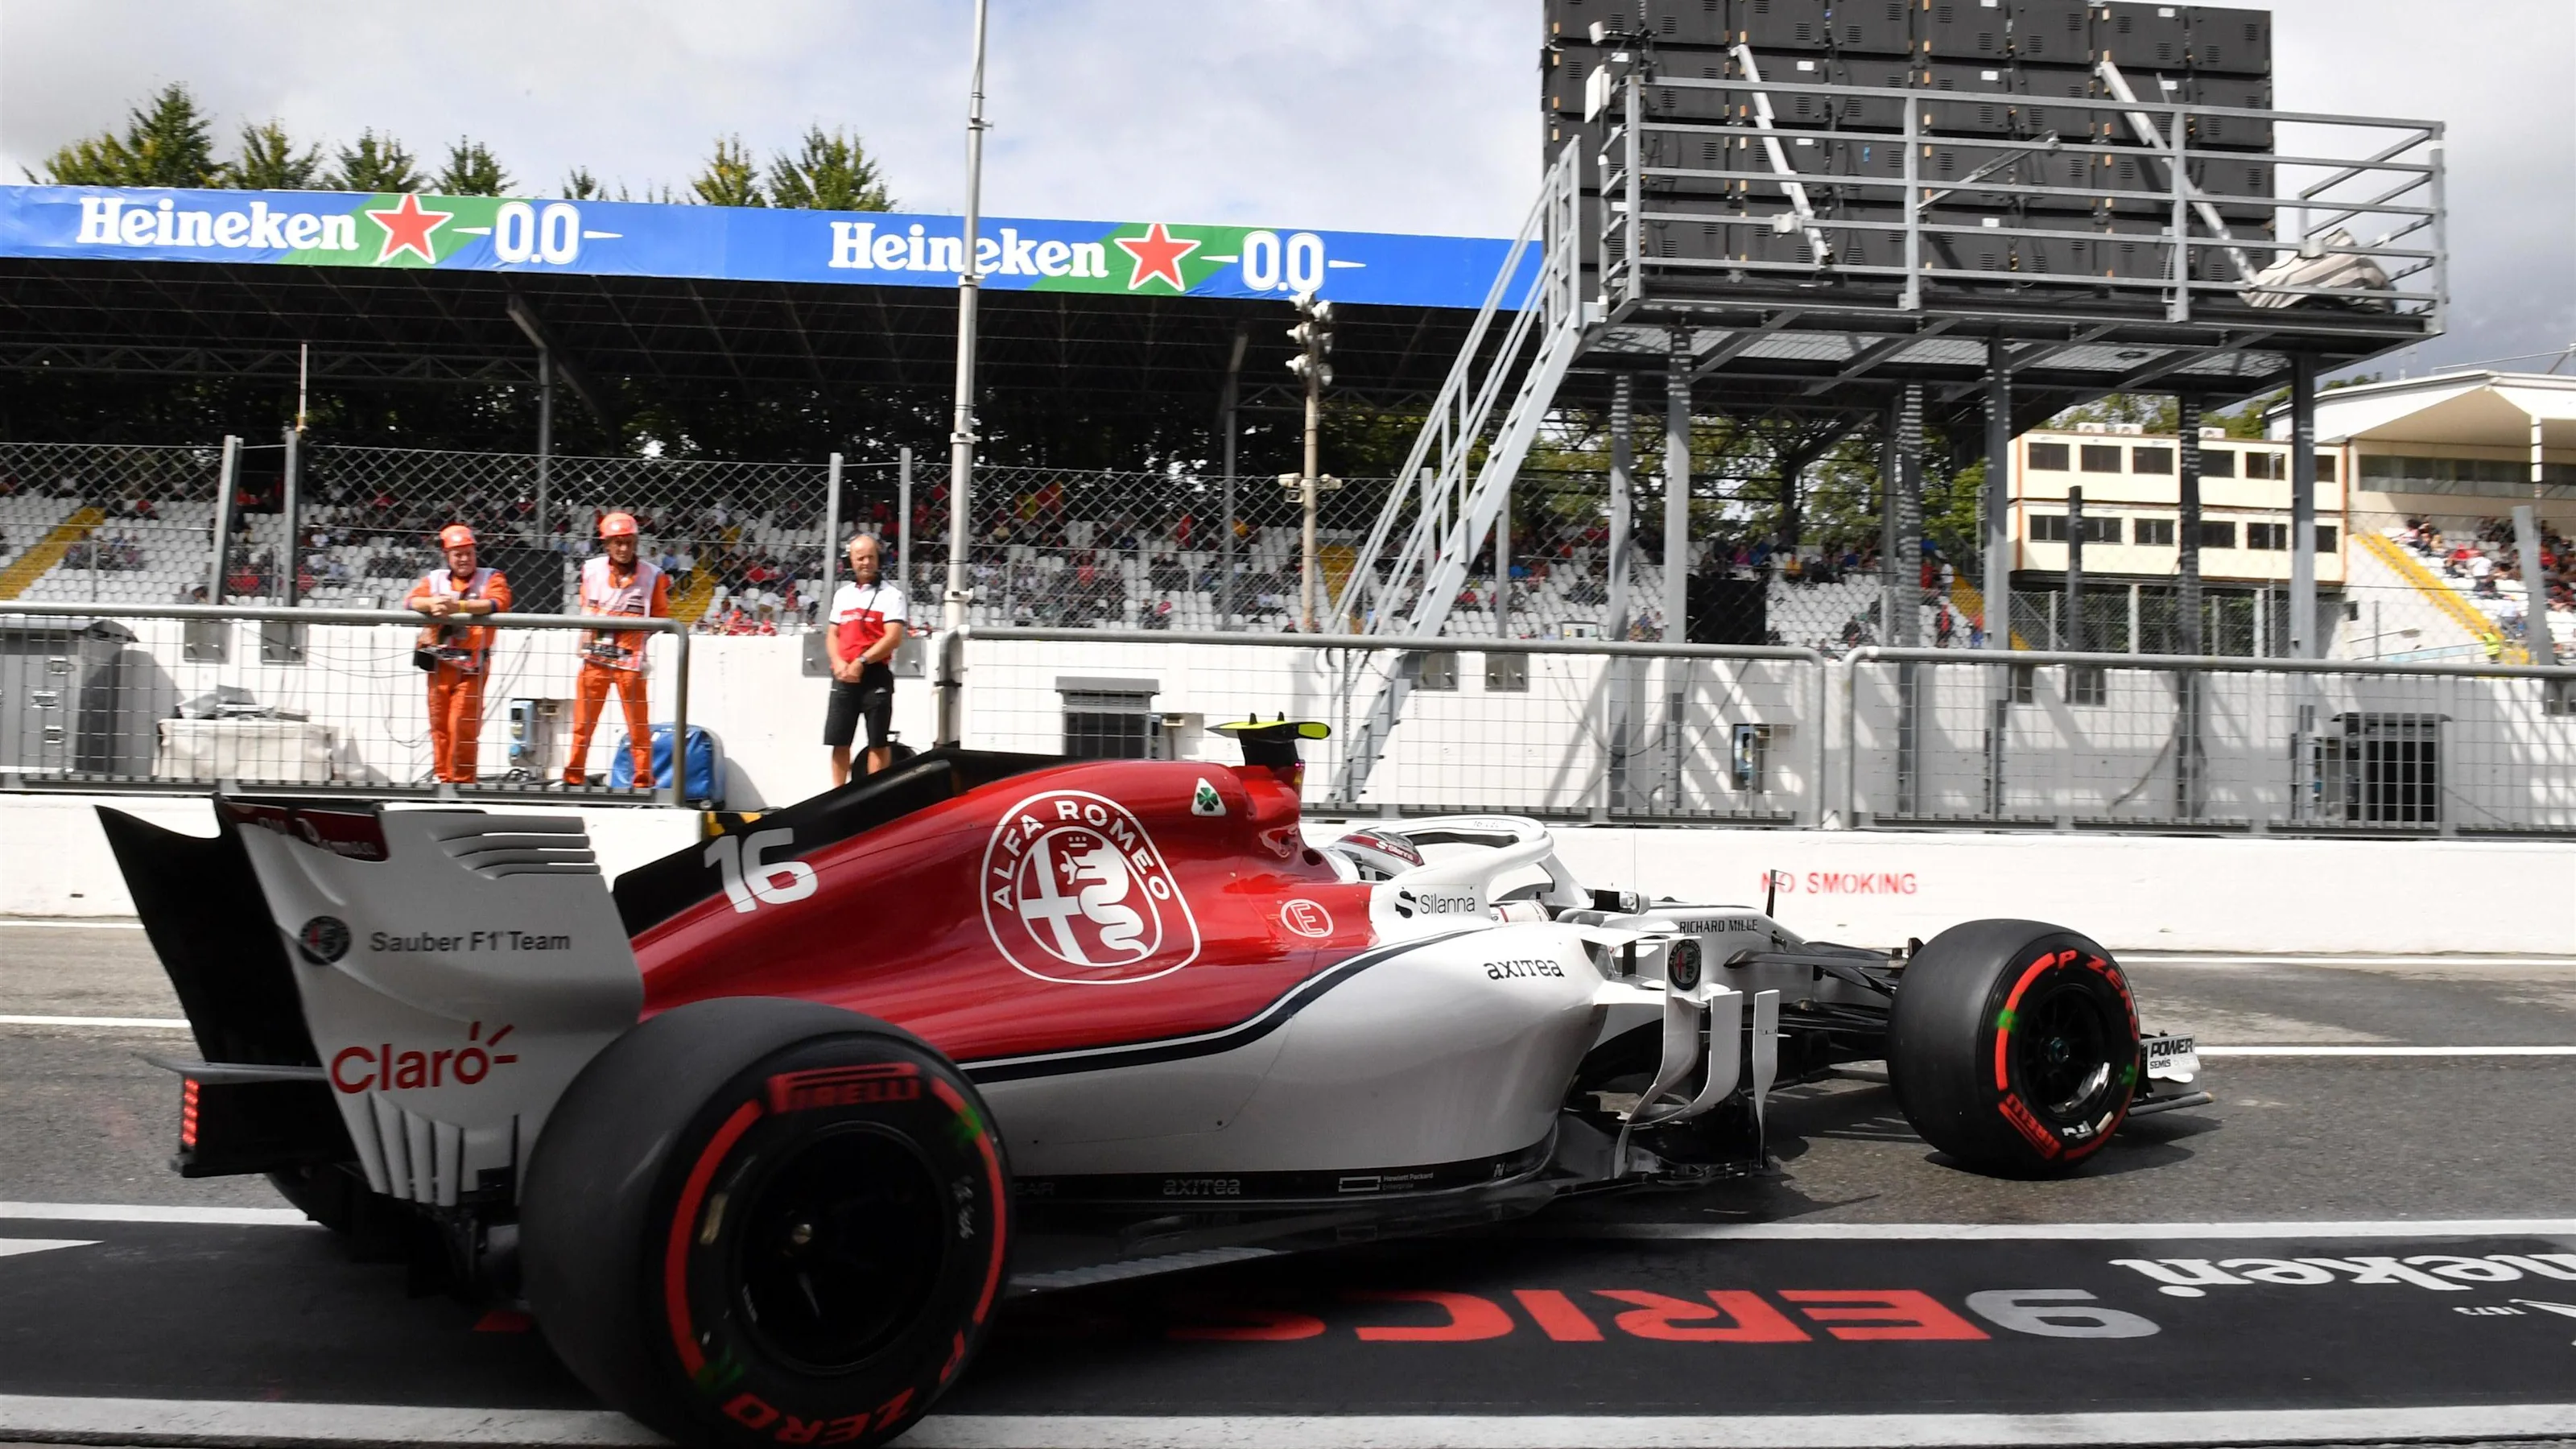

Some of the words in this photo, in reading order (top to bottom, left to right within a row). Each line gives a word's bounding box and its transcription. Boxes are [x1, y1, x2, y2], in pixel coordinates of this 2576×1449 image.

[76, 196, 360, 251] Heineken
[493, 200, 582, 265] 0.0
[828, 221, 1108, 279] Heineken
[1241, 230, 1325, 292] 0.0
[704, 828, 819, 914] 16
[993, 815, 1045, 911] ALFA
[1055, 800, 1170, 901] ROMEO
[1420, 894, 1476, 914] Silanna
[1761, 872, 1796, 893] NO
[1806, 872, 1917, 894] SMOKING
[370, 931, 463, 952] Sauber
[510, 931, 571, 950] Team
[1679, 920, 1725, 934] RICHARD
[1728, 919, 1758, 931] MILLE
[2058, 949, 2079, 969] P
[332, 1042, 490, 1094] Claro
[2150, 1038, 2194, 1058] POWER
[767, 1061, 921, 1114] PIRELLI
[721, 1386, 916, 1446] ZERO
